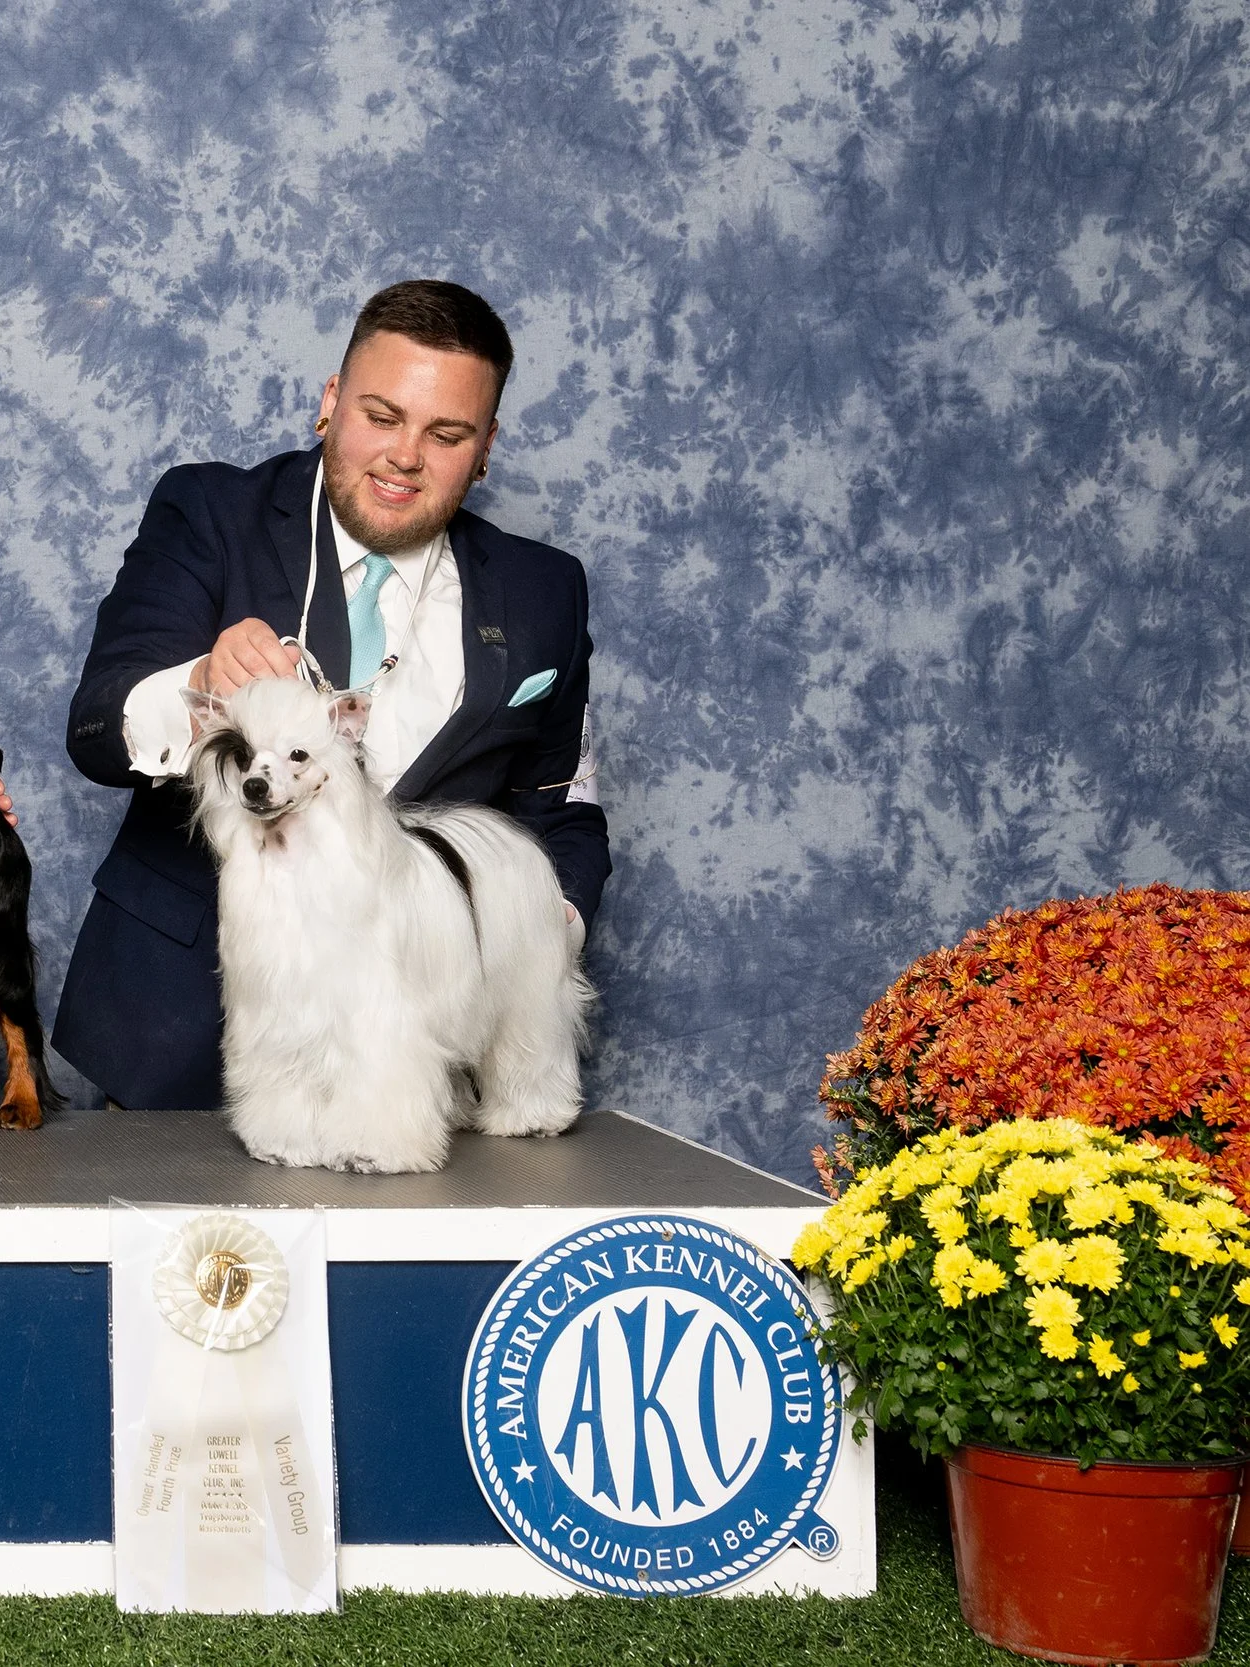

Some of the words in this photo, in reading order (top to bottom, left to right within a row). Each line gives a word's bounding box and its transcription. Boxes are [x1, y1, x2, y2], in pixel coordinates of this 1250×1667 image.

[497, 1252, 615, 1440] AMERICAN
[622, 1244, 771, 1323] KENNEL
[766, 1321, 812, 1425] CLUB
[554, 1296, 757, 1520] AKC
[144, 1433, 165, 1478] Handled
[207, 1436, 241, 1446] GREATER
[208, 1450, 238, 1460] LOWELL
[165, 1446, 181, 1472] Prize
[208, 1464, 239, 1474] KENNEL
[136, 1483, 155, 1516] Owner
[156, 1477, 175, 1512] Fourth
[203, 1478, 225, 1488] CLUB,
[230, 1478, 245, 1488] INC.
[274, 1435, 299, 1486] Variety
[287, 1491, 308, 1535] Group
[551, 1514, 694, 1570] FOUNDED
[708, 1507, 770, 1557] 1884
